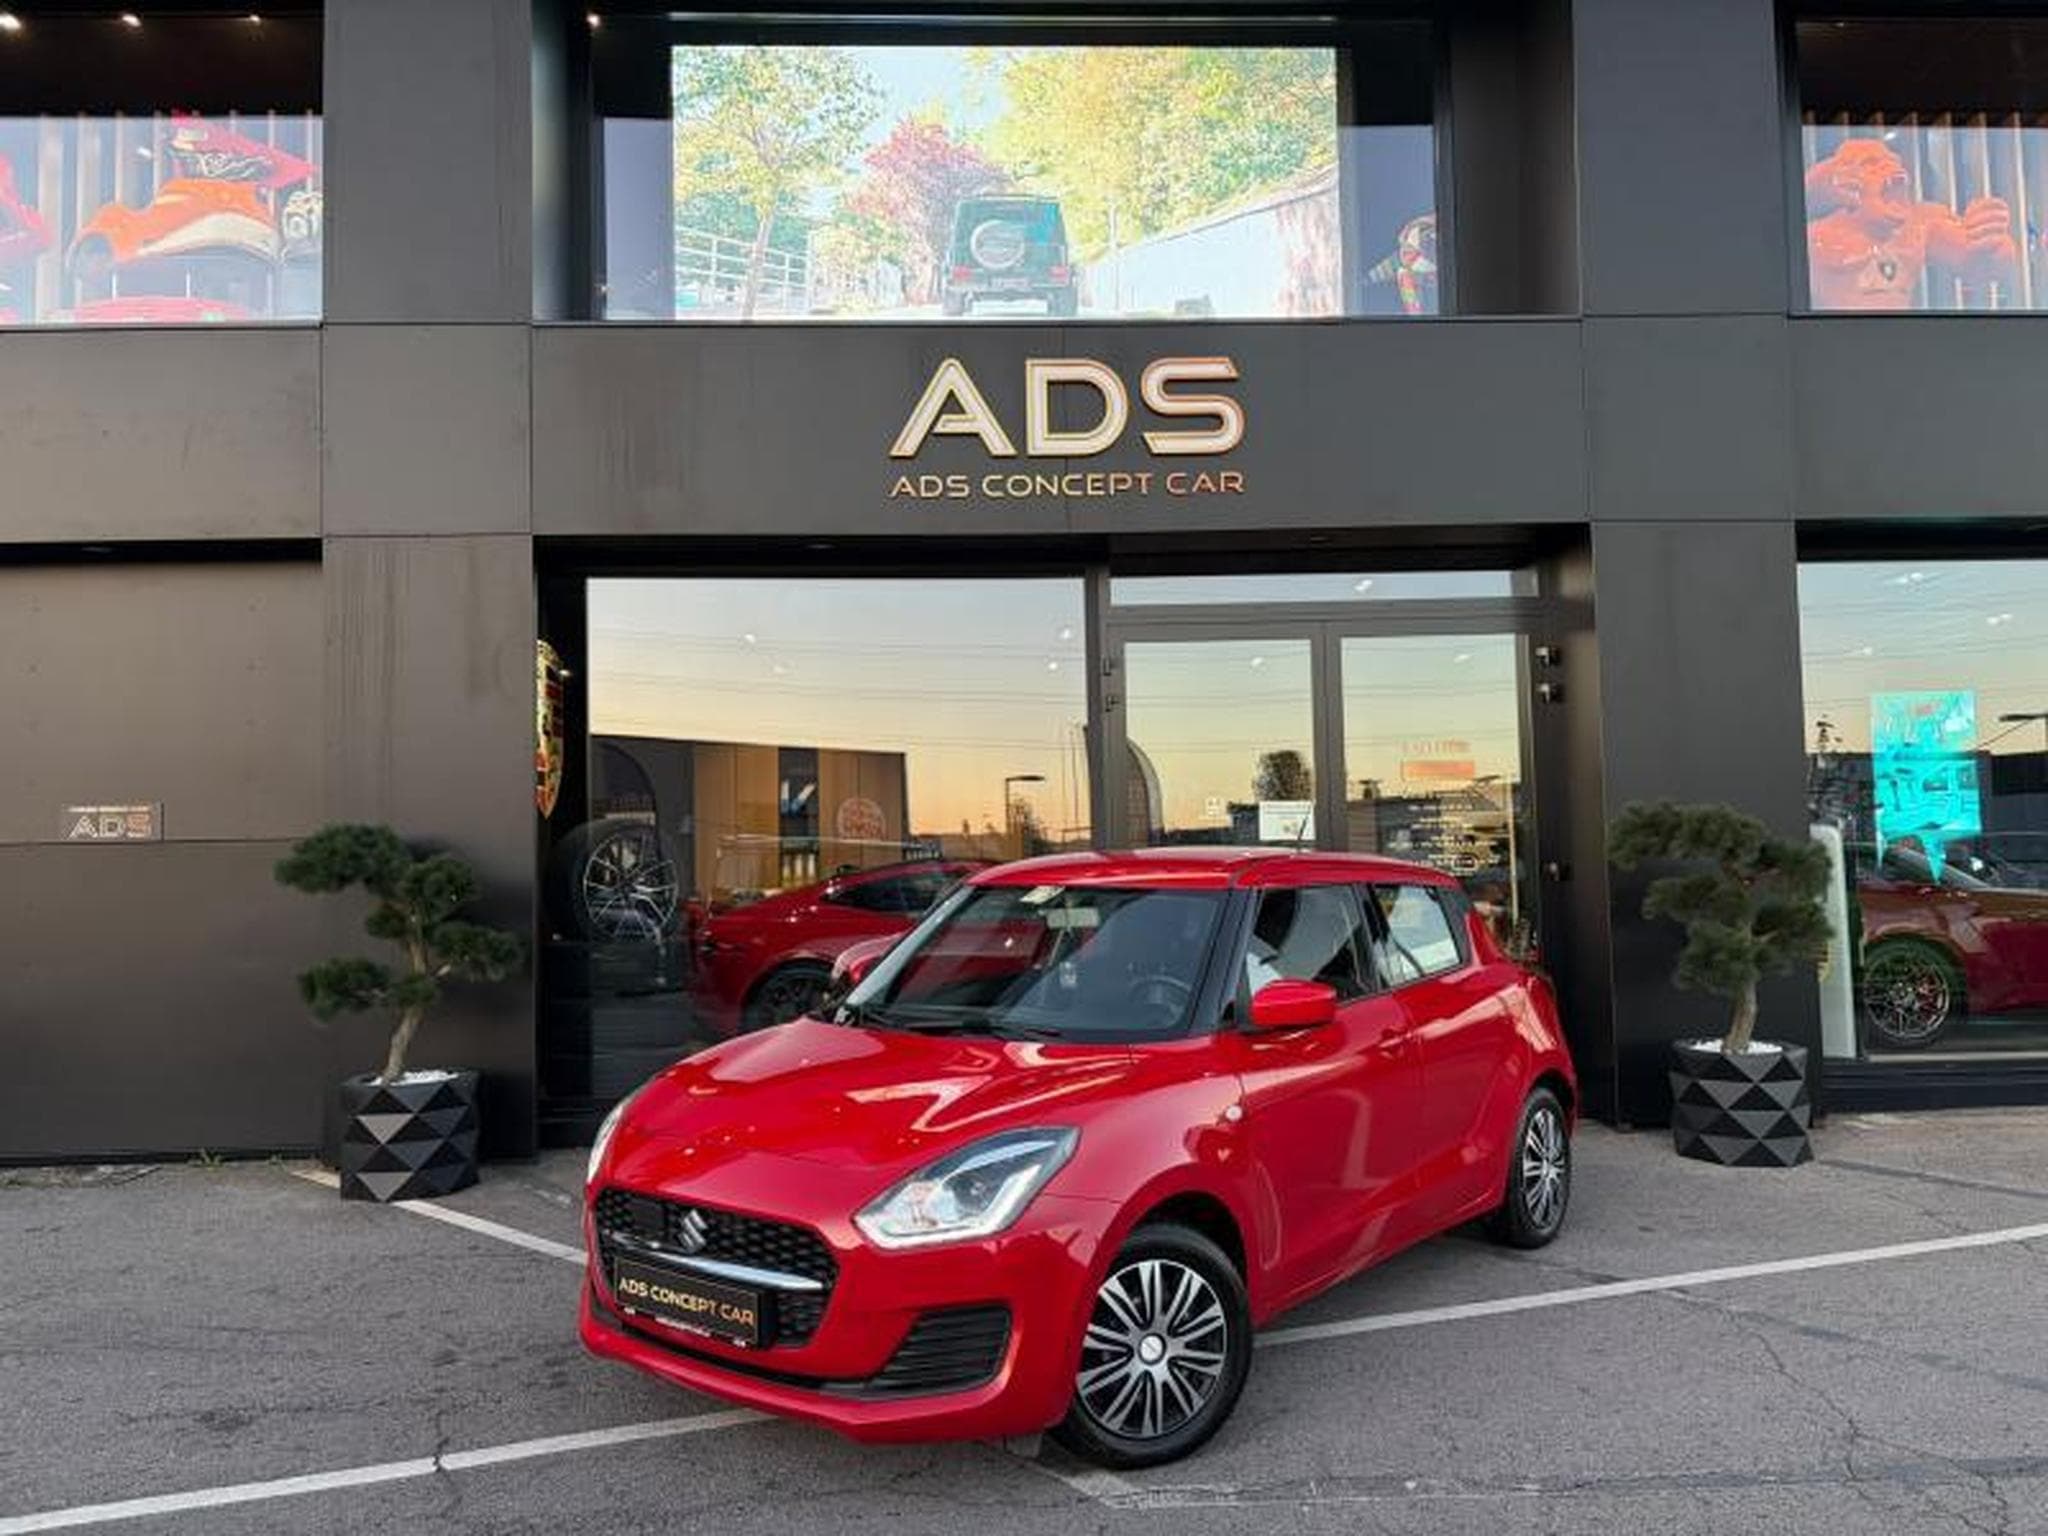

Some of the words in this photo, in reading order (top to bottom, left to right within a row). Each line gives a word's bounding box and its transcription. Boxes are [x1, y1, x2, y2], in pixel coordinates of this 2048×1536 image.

[889, 356, 1246, 457] ADS
[889, 474, 970, 498] ADS
[981, 472, 1153, 498] CONCEPT
[1165, 471, 1245, 495] CAR
[66, 813, 152, 841] ADS
[618, 1277, 649, 1297] ADS
[650, 1285, 716, 1316] CONCEPT
[720, 1303, 755, 1326] CAR
